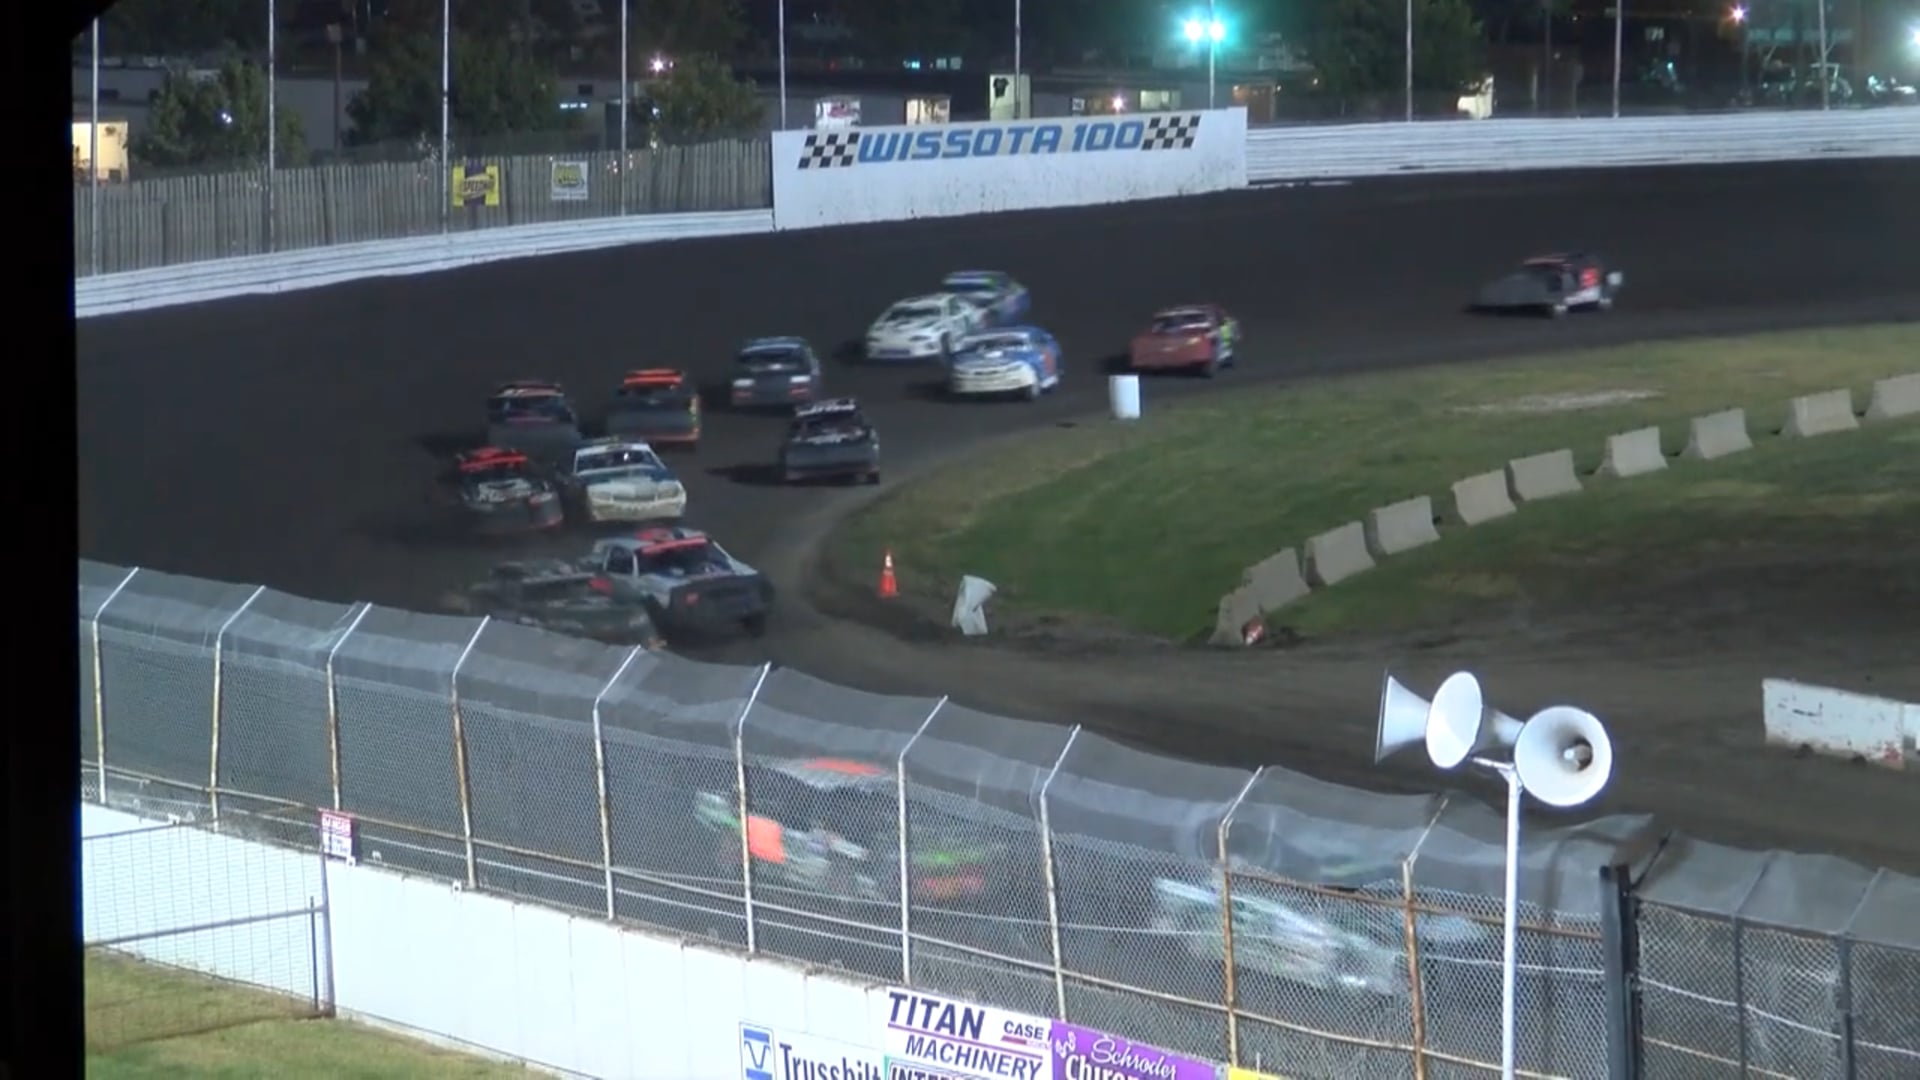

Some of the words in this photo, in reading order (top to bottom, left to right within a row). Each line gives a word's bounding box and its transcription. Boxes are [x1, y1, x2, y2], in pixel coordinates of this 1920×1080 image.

[858, 125, 1063, 163] WISSOTA
[1072, 120, 1145, 152] 100
[889, 991, 985, 1040] TITAN
[1003, 1020, 1044, 1040] CASE
[905, 1035, 1043, 1080] MACHINERY
[1091, 1037, 1176, 1080] Schroder
